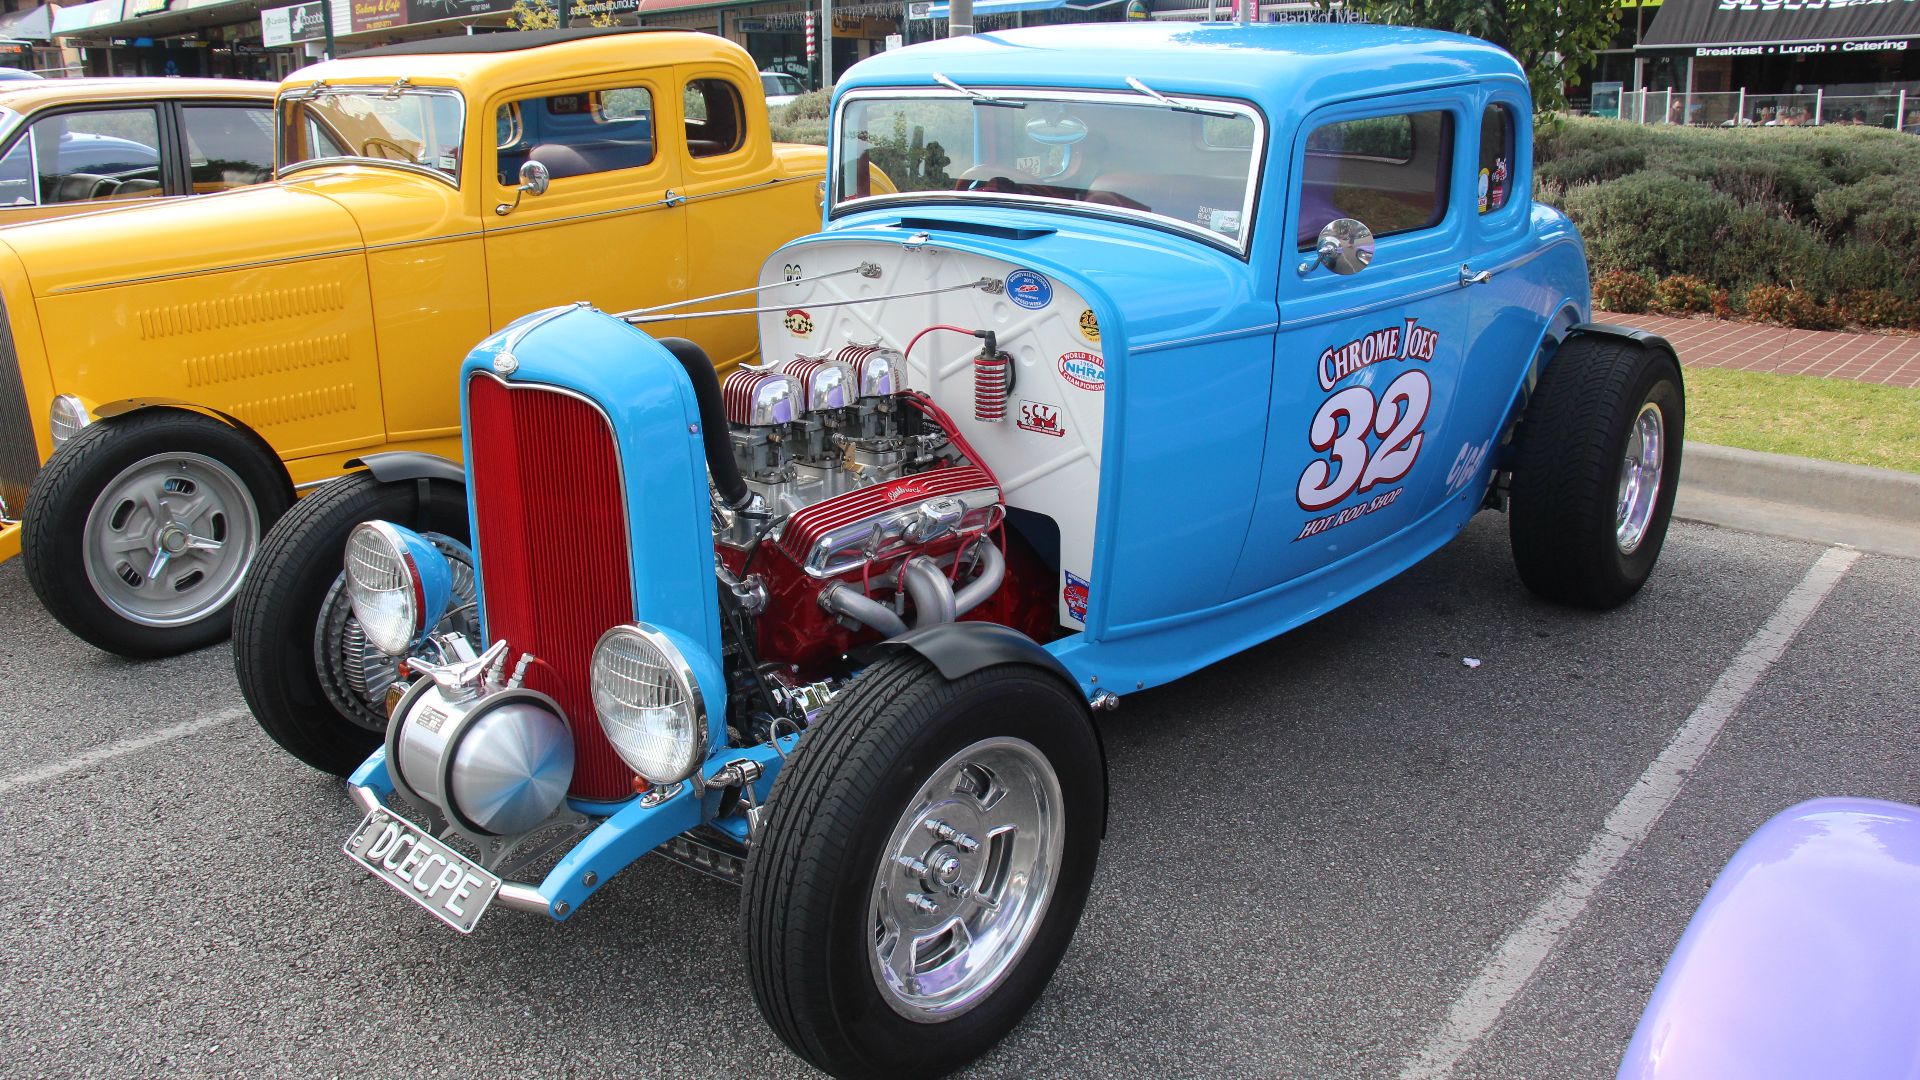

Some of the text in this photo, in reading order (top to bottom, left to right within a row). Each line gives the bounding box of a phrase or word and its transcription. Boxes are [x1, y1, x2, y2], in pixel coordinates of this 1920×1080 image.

[1696, 40, 1908, 56] Breakfast Lunch Catering
[1063, 352, 1104, 367] WORLD SERI
[1317, 318, 1440, 392] CHROME JOES
[1066, 361, 1104, 380] NHRA
[1063, 372, 1104, 391] CHAMPIONSHI
[1296, 369, 1432, 512] 32
[1291, 487, 1404, 543] HOT ROD SHOP
